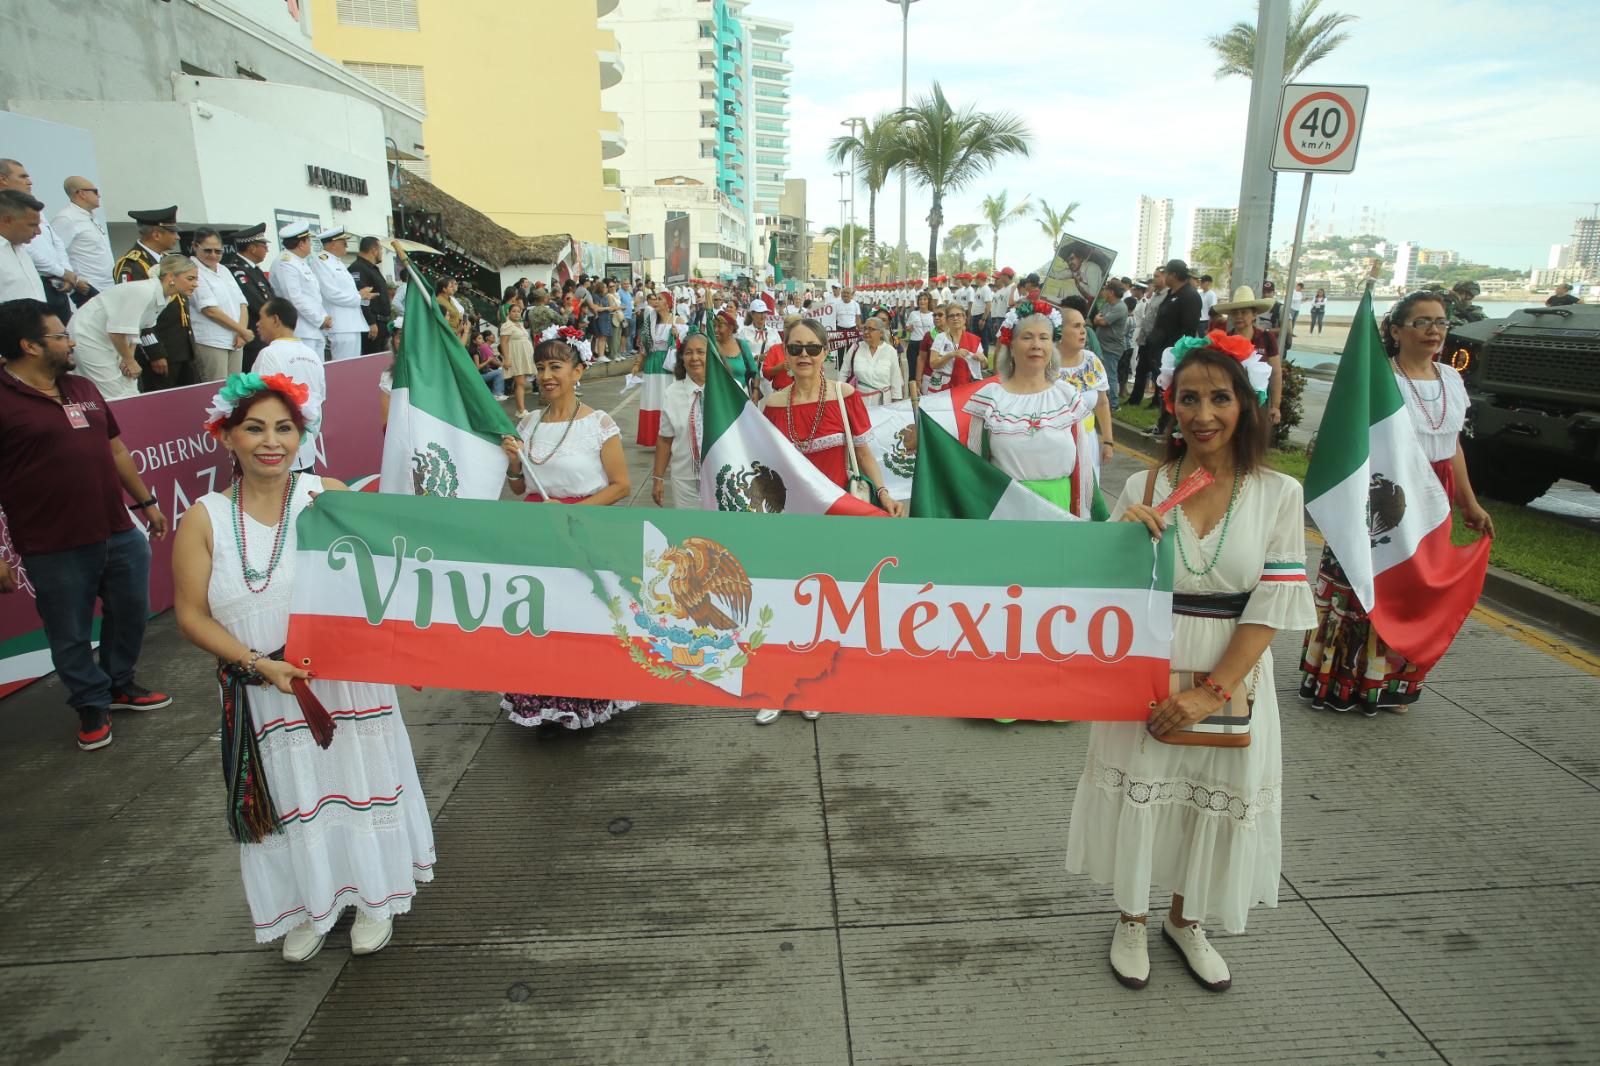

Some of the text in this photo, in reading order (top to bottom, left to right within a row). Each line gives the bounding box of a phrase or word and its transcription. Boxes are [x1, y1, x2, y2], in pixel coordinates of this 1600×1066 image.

[1299, 107, 1341, 139] 40
[1301, 141, 1331, 150] km/h
[130, 431, 217, 474] OBIERNO
[327, 535, 1134, 663] Viva México
